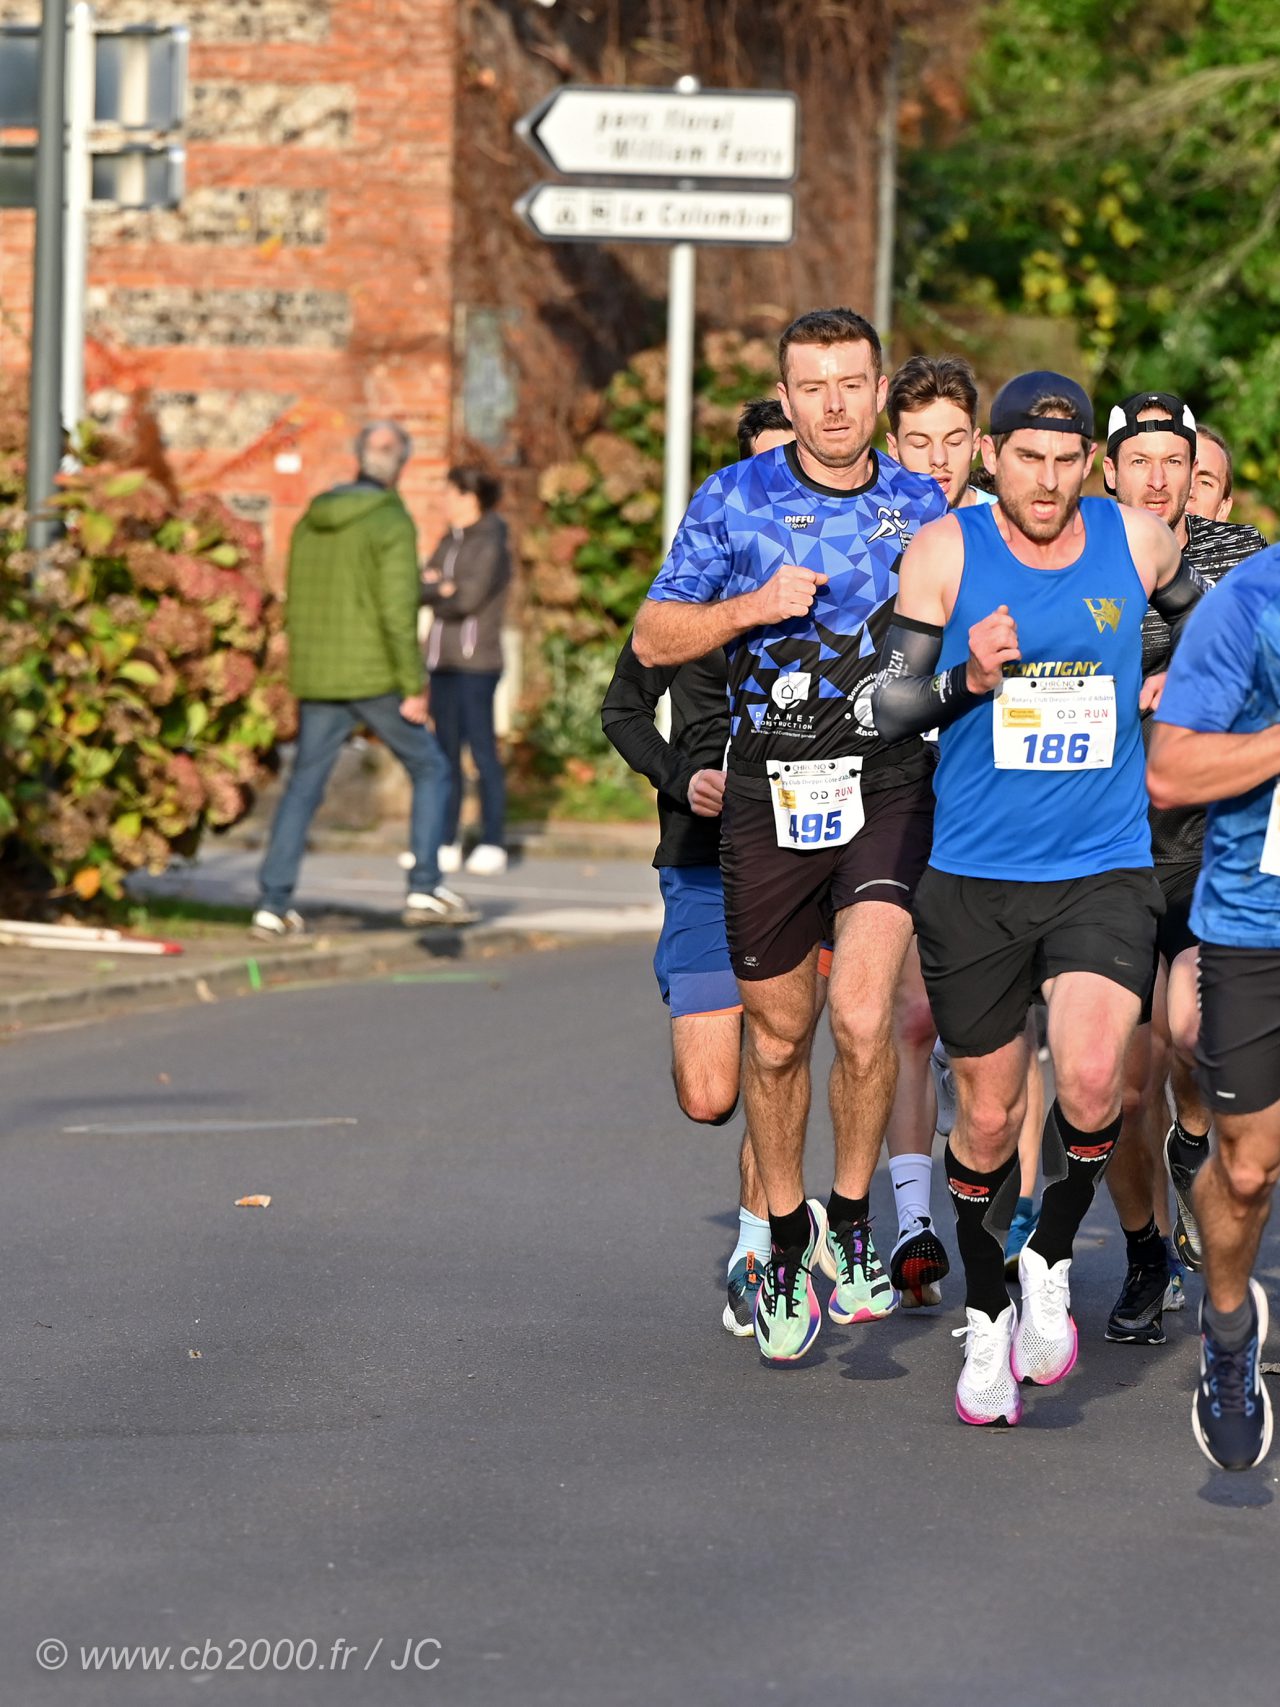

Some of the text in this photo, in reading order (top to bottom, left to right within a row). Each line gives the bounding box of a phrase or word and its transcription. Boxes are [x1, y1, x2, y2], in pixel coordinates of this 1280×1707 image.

[784, 515, 815, 524] DIFFU
[755, 711, 815, 723] PLANET
[1084, 709, 1109, 719] RUN
[755, 720, 813, 730] CONSTRUCTION
[1023, 733, 1090, 764] 186
[834, 786, 853, 798] RUN
[789, 810, 842, 843] 495
